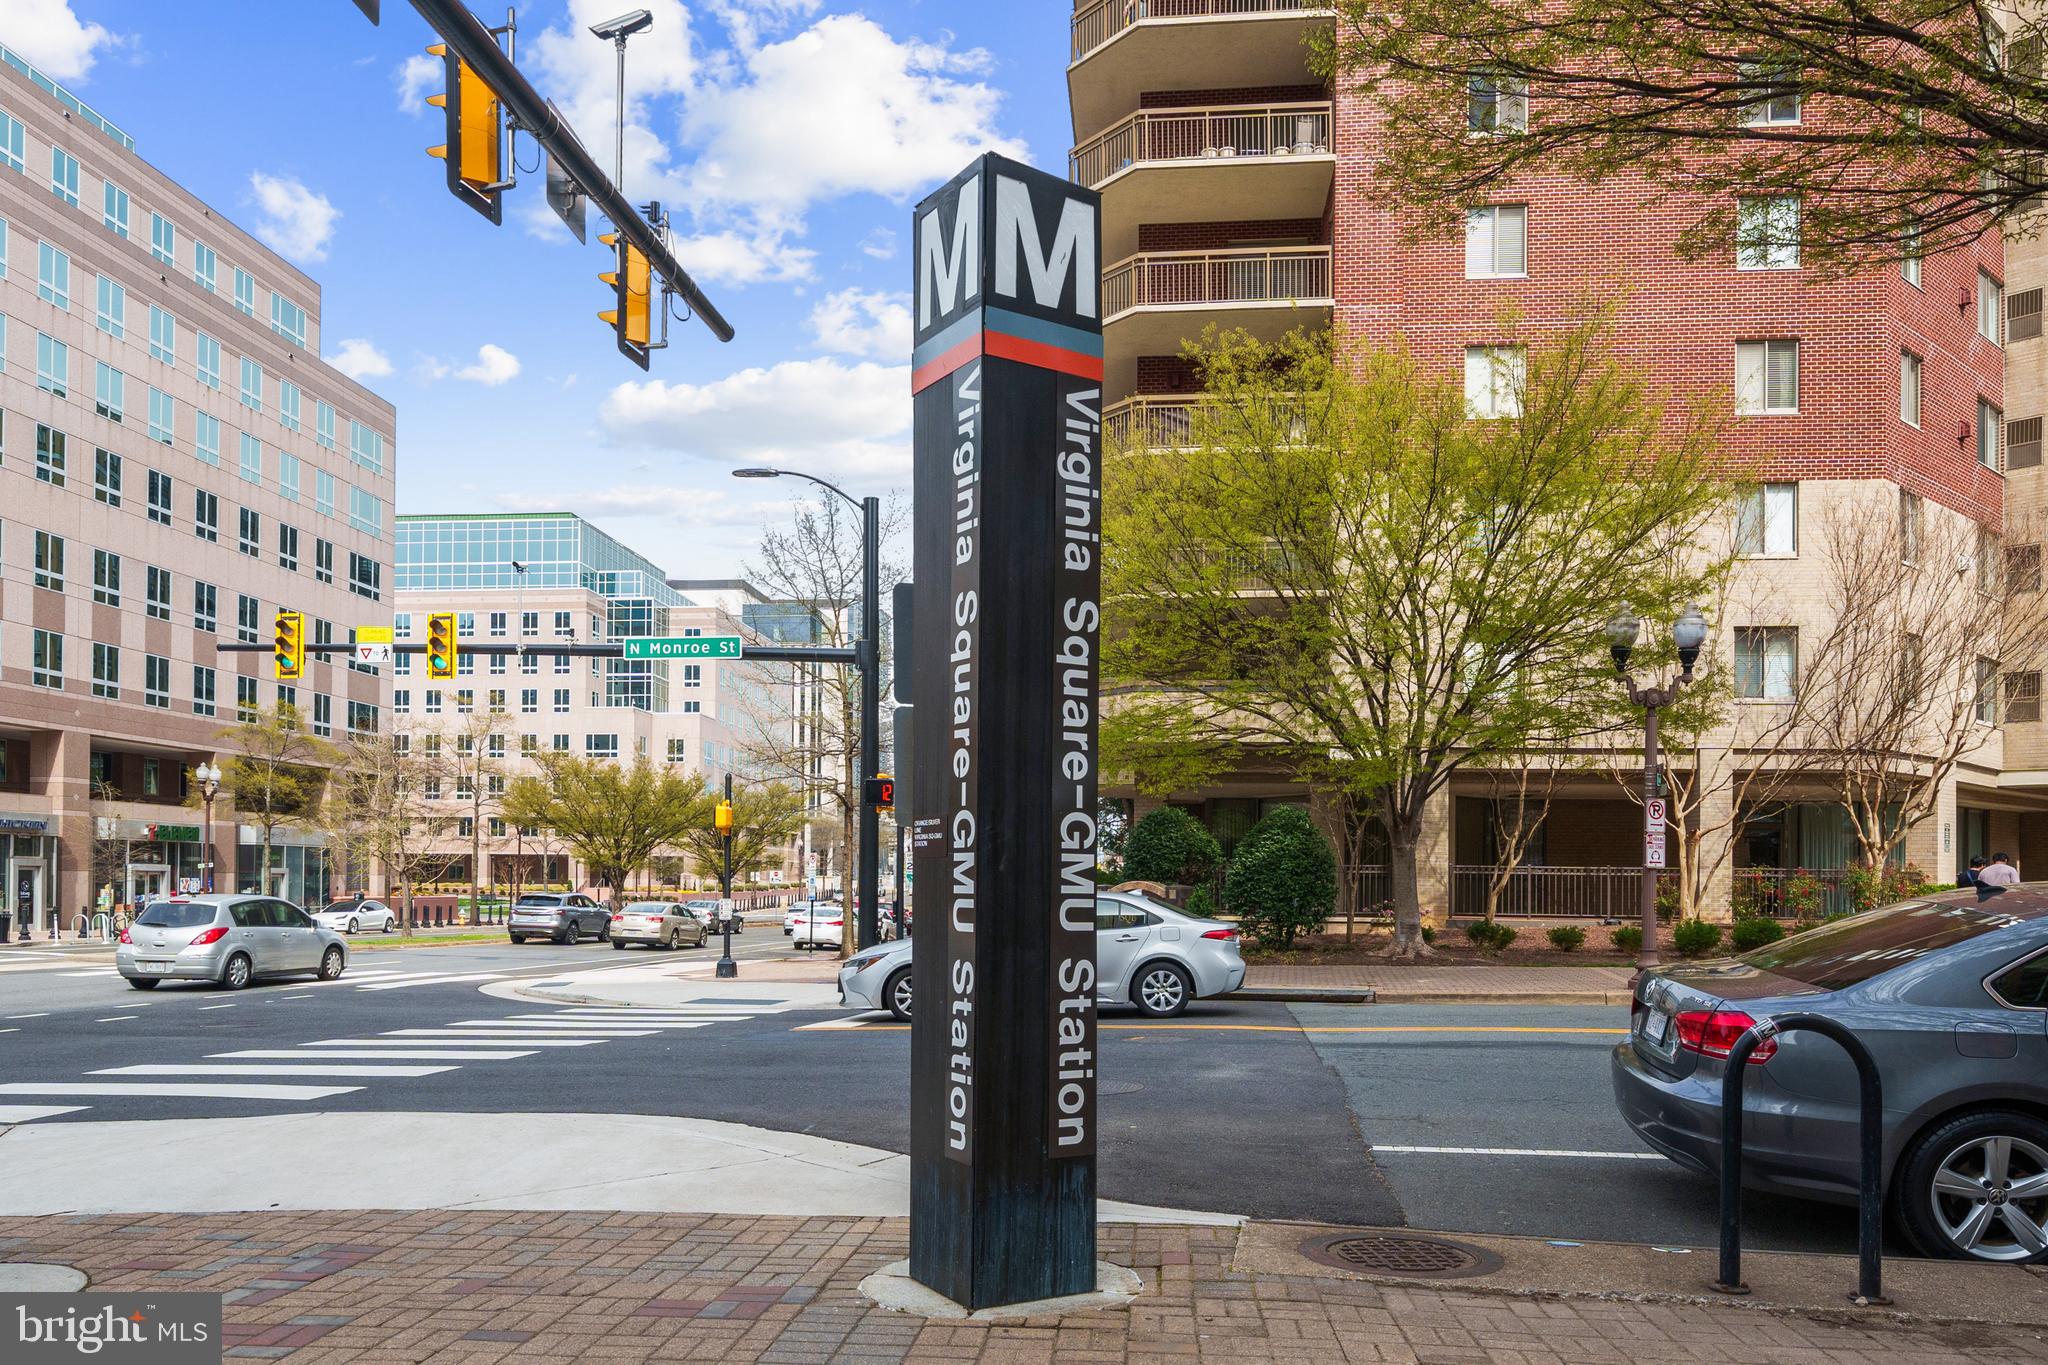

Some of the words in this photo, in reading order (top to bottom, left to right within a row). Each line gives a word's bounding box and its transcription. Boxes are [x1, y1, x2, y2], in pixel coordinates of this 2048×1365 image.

[919, 174, 980, 332] M
[995, 174, 1097, 319] M
[953, 365, 981, 566] Virginia
[1056, 388, 1100, 571] Virginia
[629, 642, 640, 655] N
[649, 642, 711, 654] Monroe
[719, 641, 736, 653] St
[950, 959, 975, 1150] Station
[1057, 958, 1096, 1146] Station
